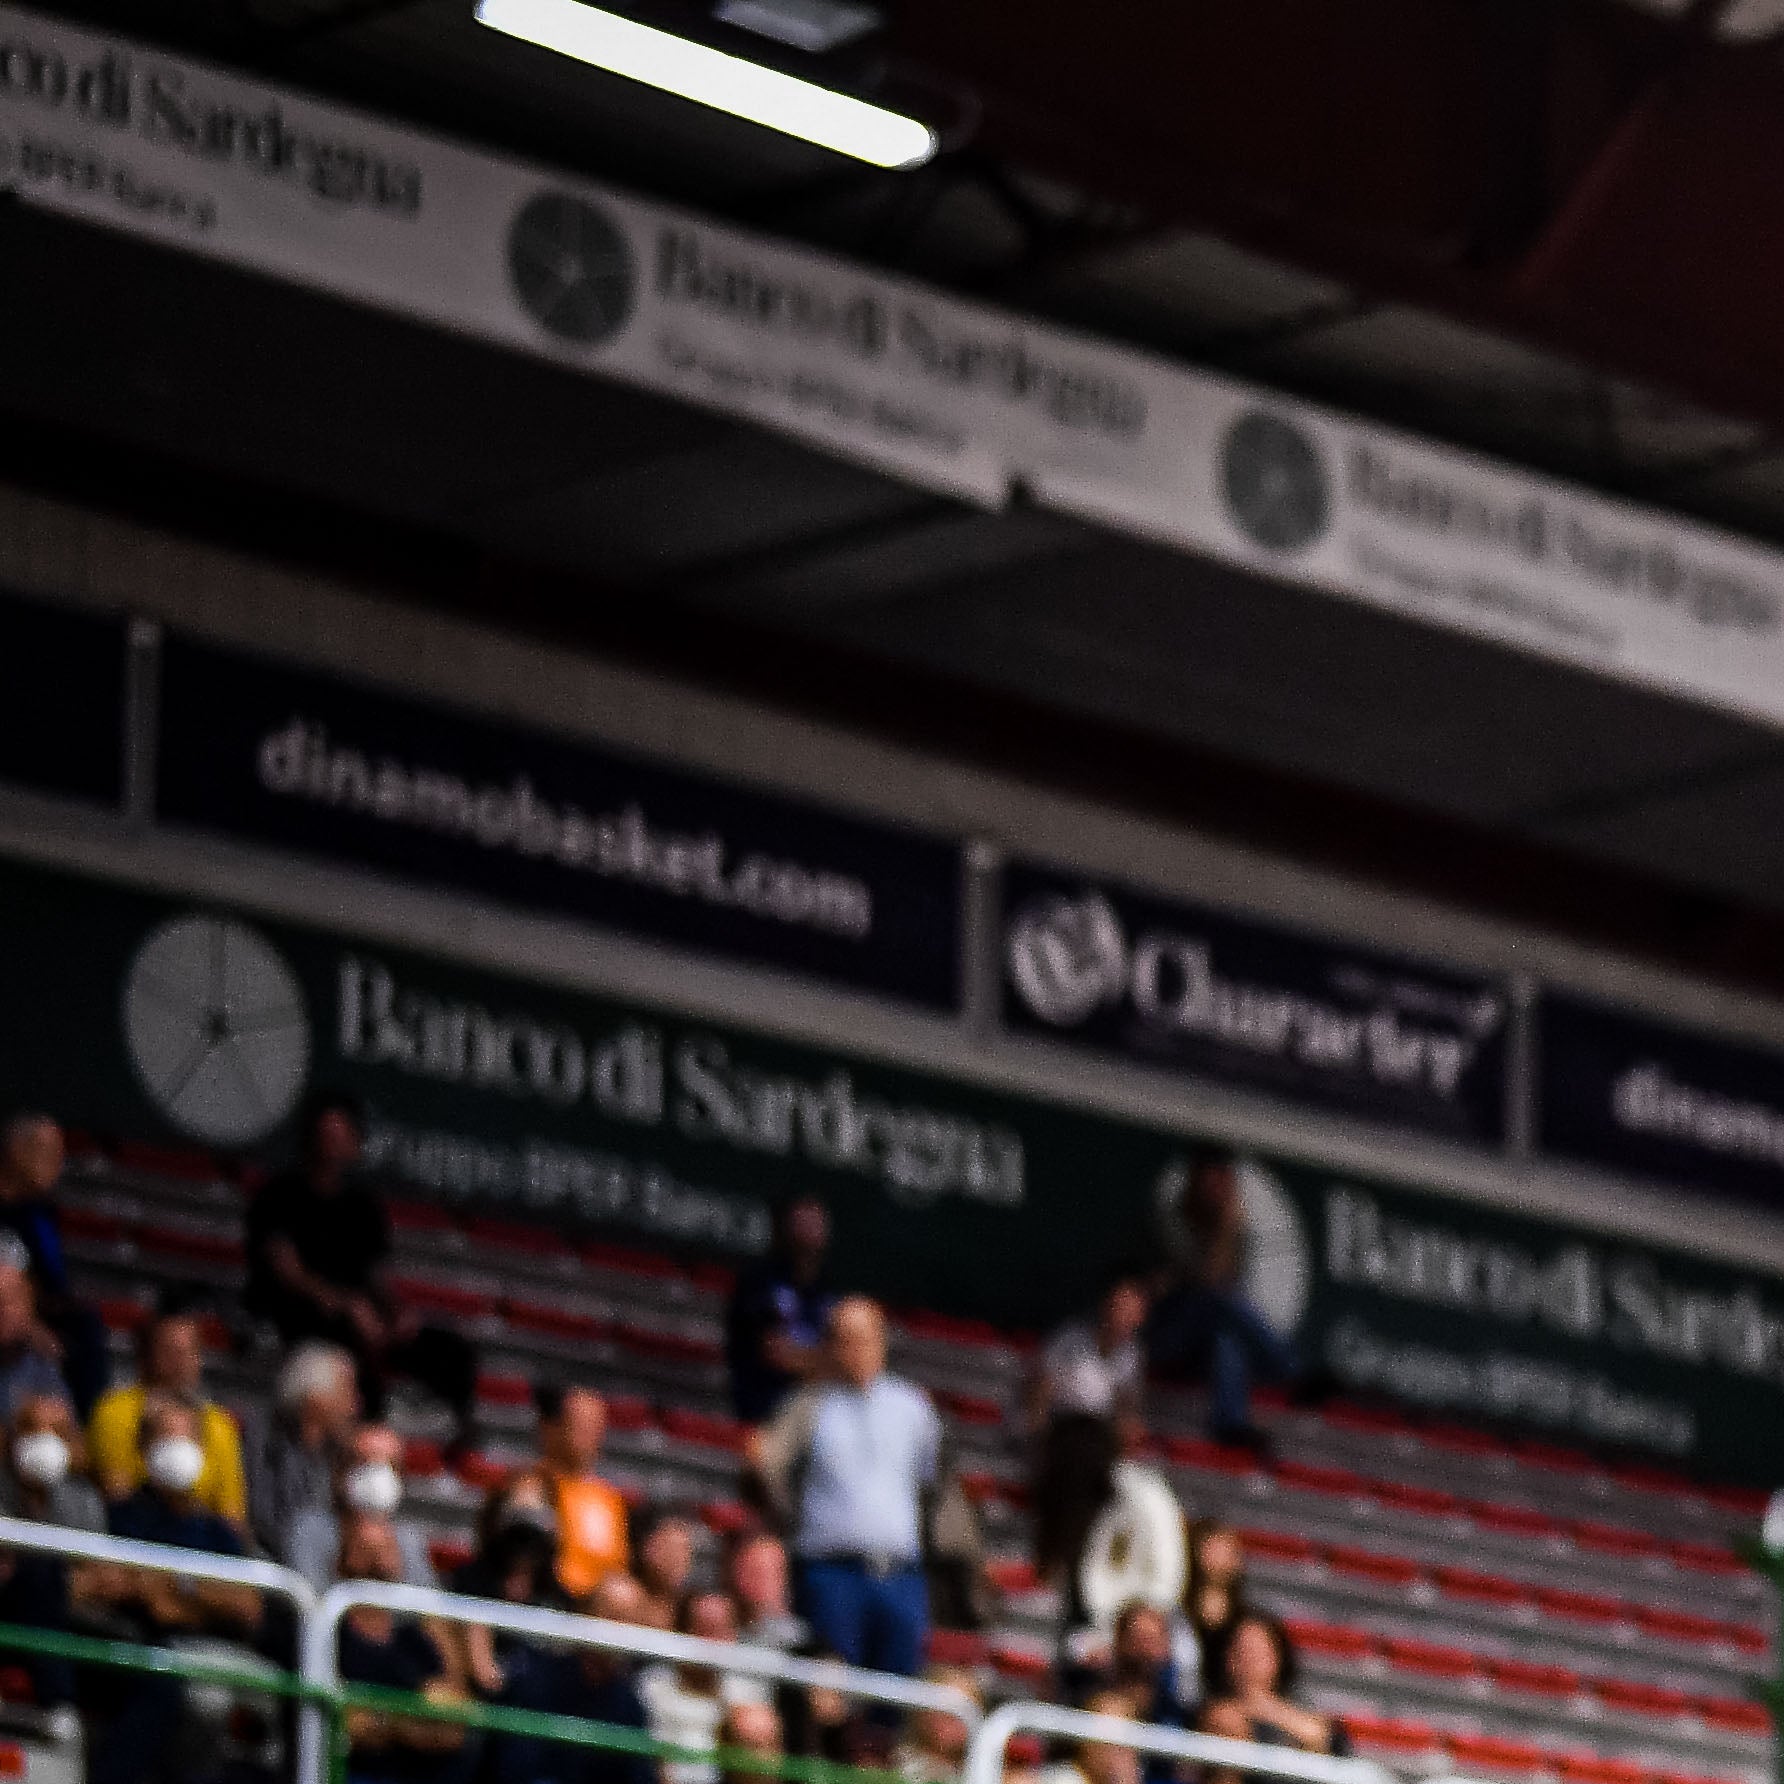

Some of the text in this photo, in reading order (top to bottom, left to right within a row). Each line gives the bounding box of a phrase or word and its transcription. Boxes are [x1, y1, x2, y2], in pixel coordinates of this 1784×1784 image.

[254, 714, 873, 942] dinamobasket.com
[337, 949, 1028, 1208] Banco di Sardegna
